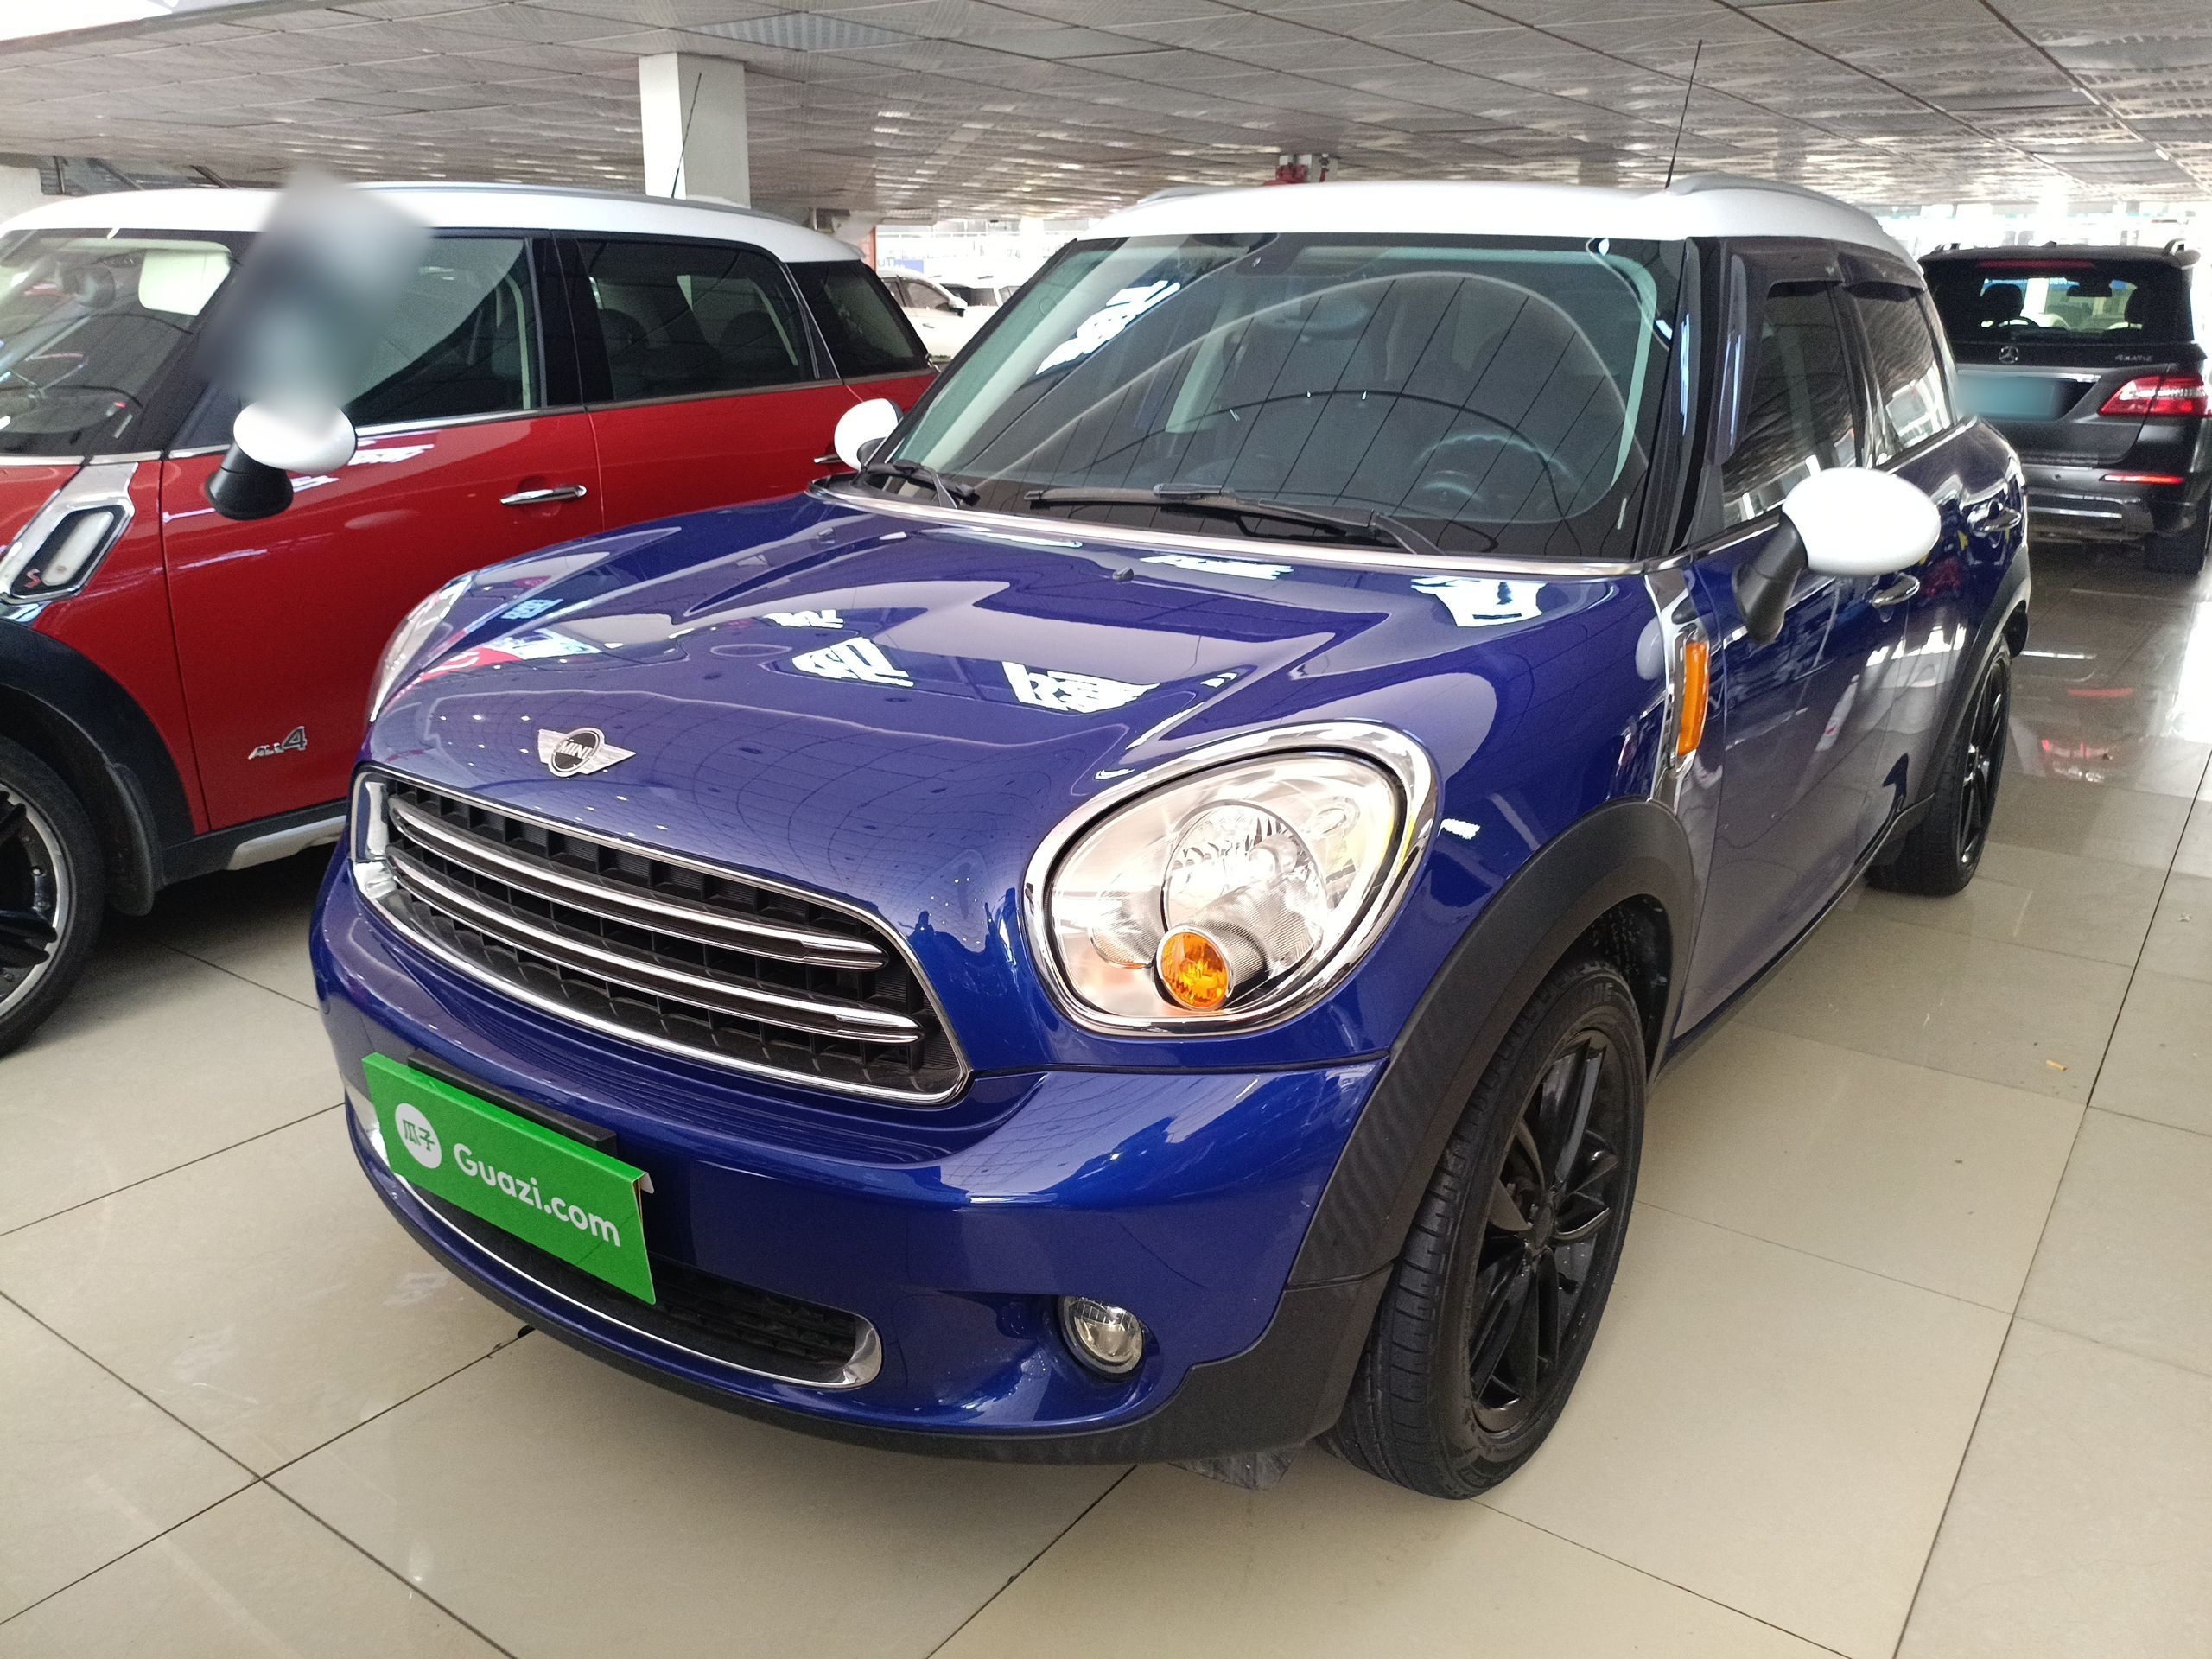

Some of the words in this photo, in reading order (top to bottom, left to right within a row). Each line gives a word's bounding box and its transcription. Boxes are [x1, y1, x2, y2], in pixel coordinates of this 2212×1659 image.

[24, 568, 41, 588] S
[557, 741, 594, 760] MINI
[402, 1119, 435, 1151] 瓜子
[453, 1142, 621, 1247] Guazi.com
